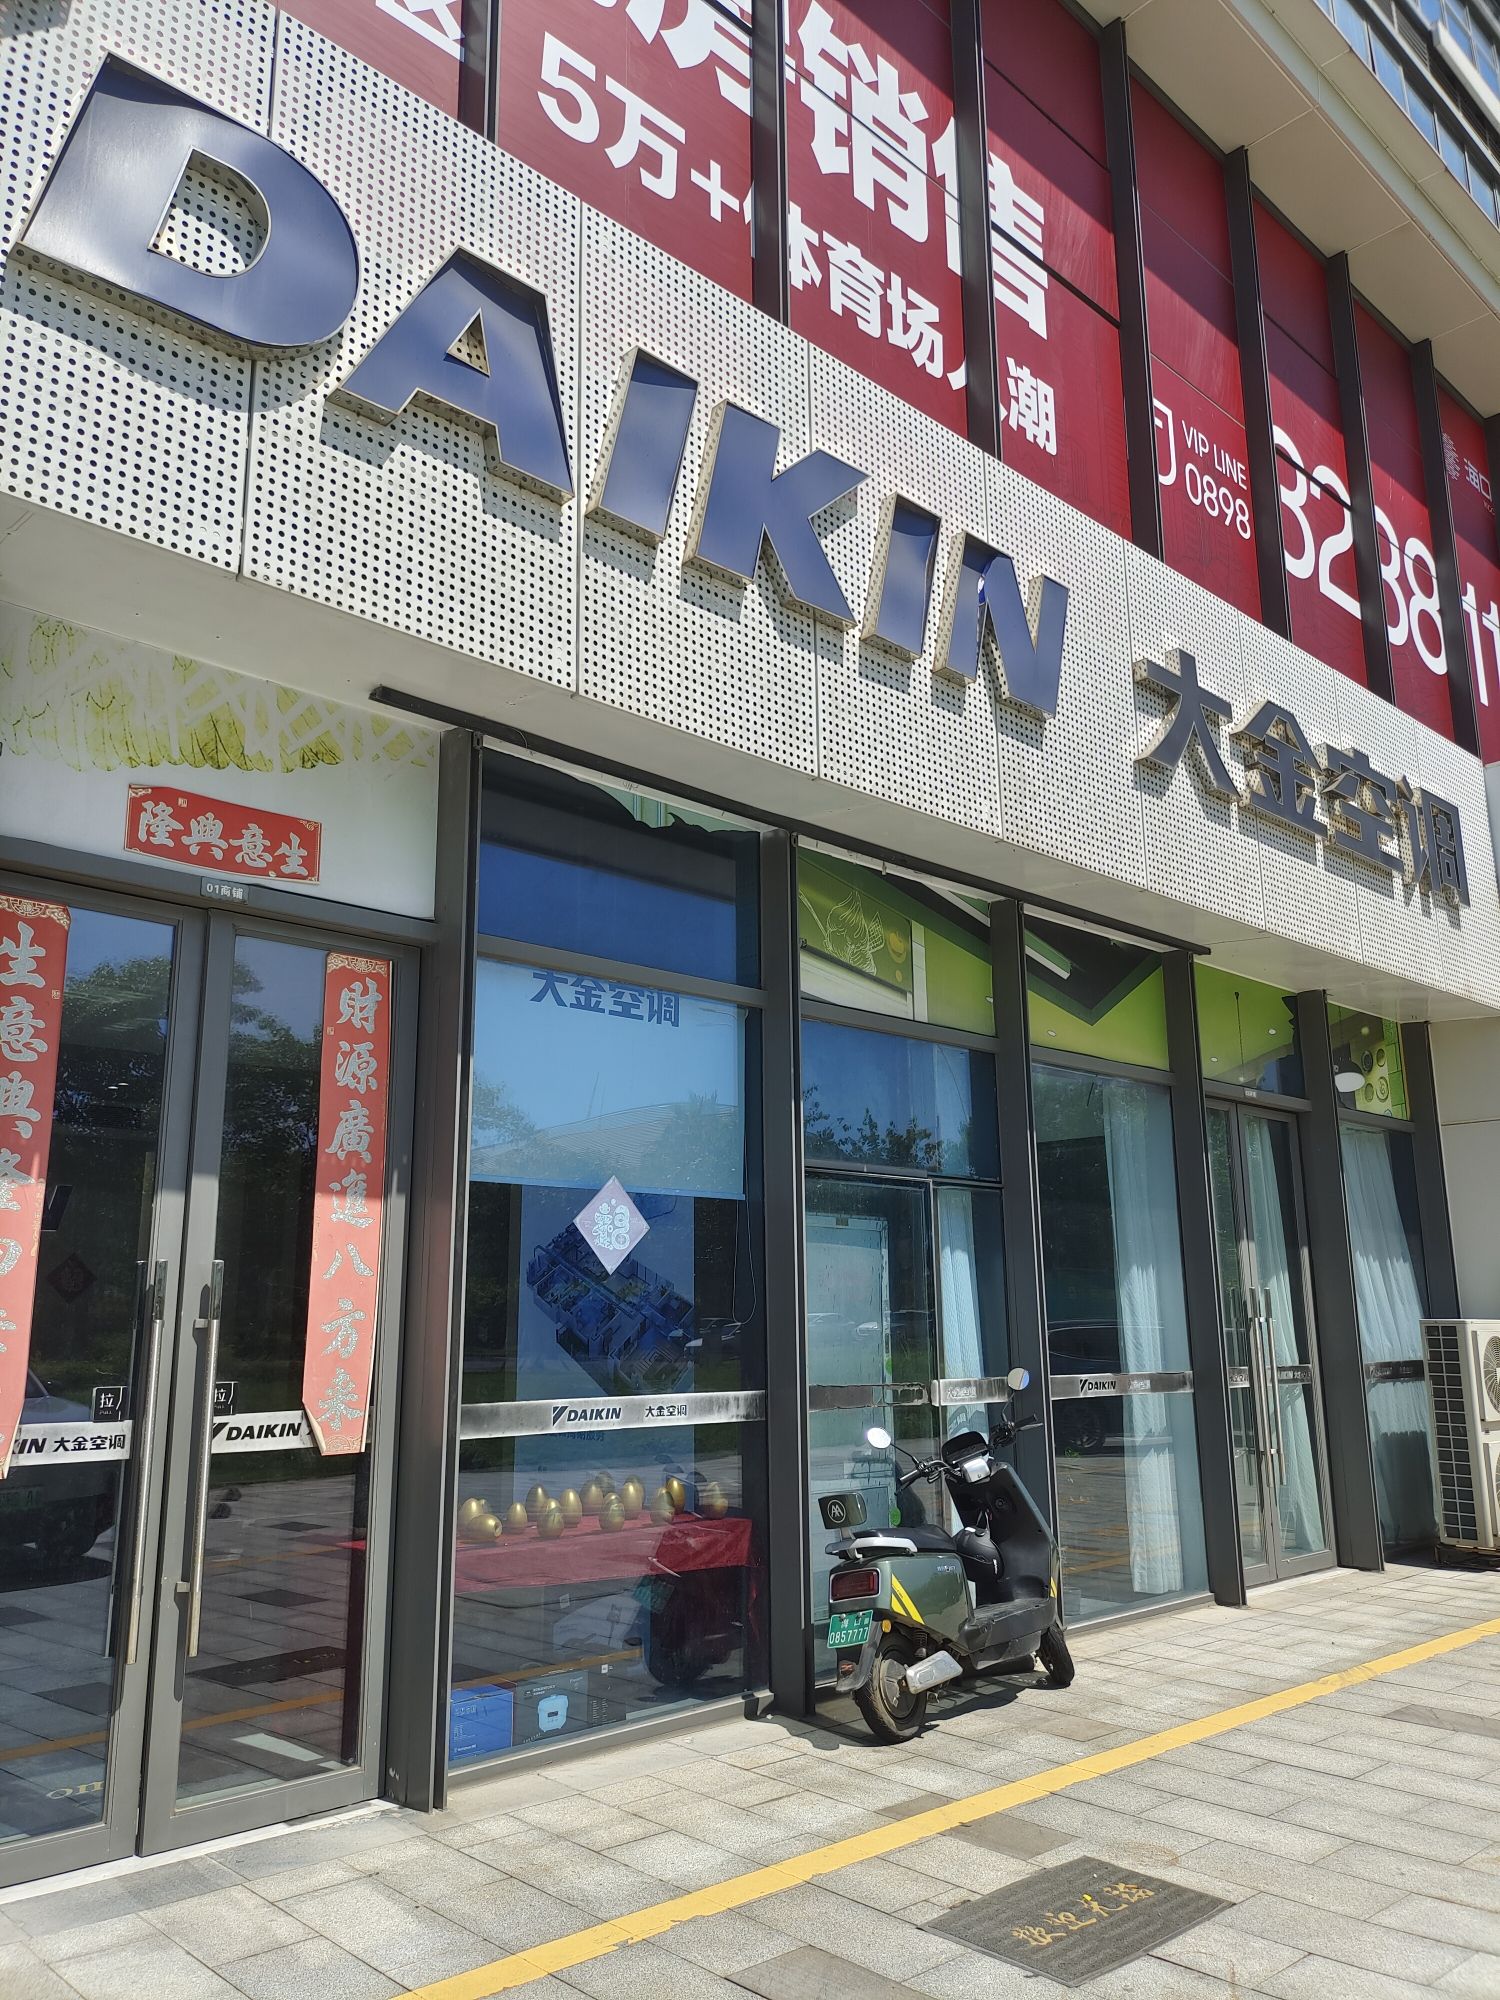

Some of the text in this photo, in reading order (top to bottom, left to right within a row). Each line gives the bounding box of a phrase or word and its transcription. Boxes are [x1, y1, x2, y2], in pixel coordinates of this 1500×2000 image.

[10, 52, 1068, 720] DAIKIN
[1181, 419, 1248, 491] VIP LINE
[1184, 462, 1251, 540] 0898
[1133, 648, 1471, 908] 大金空调
[1087, 1380, 1117, 1391] DAIKIN
[99, 1392, 115, 1408] 拉
[566, 1404, 688, 1422] DAIKIN 大金空调
[225, 1422, 302, 1441] DAIKIN
[52, 1434, 127, 1453] 大金空调
[829, 1626, 869, 1644] 0857777
